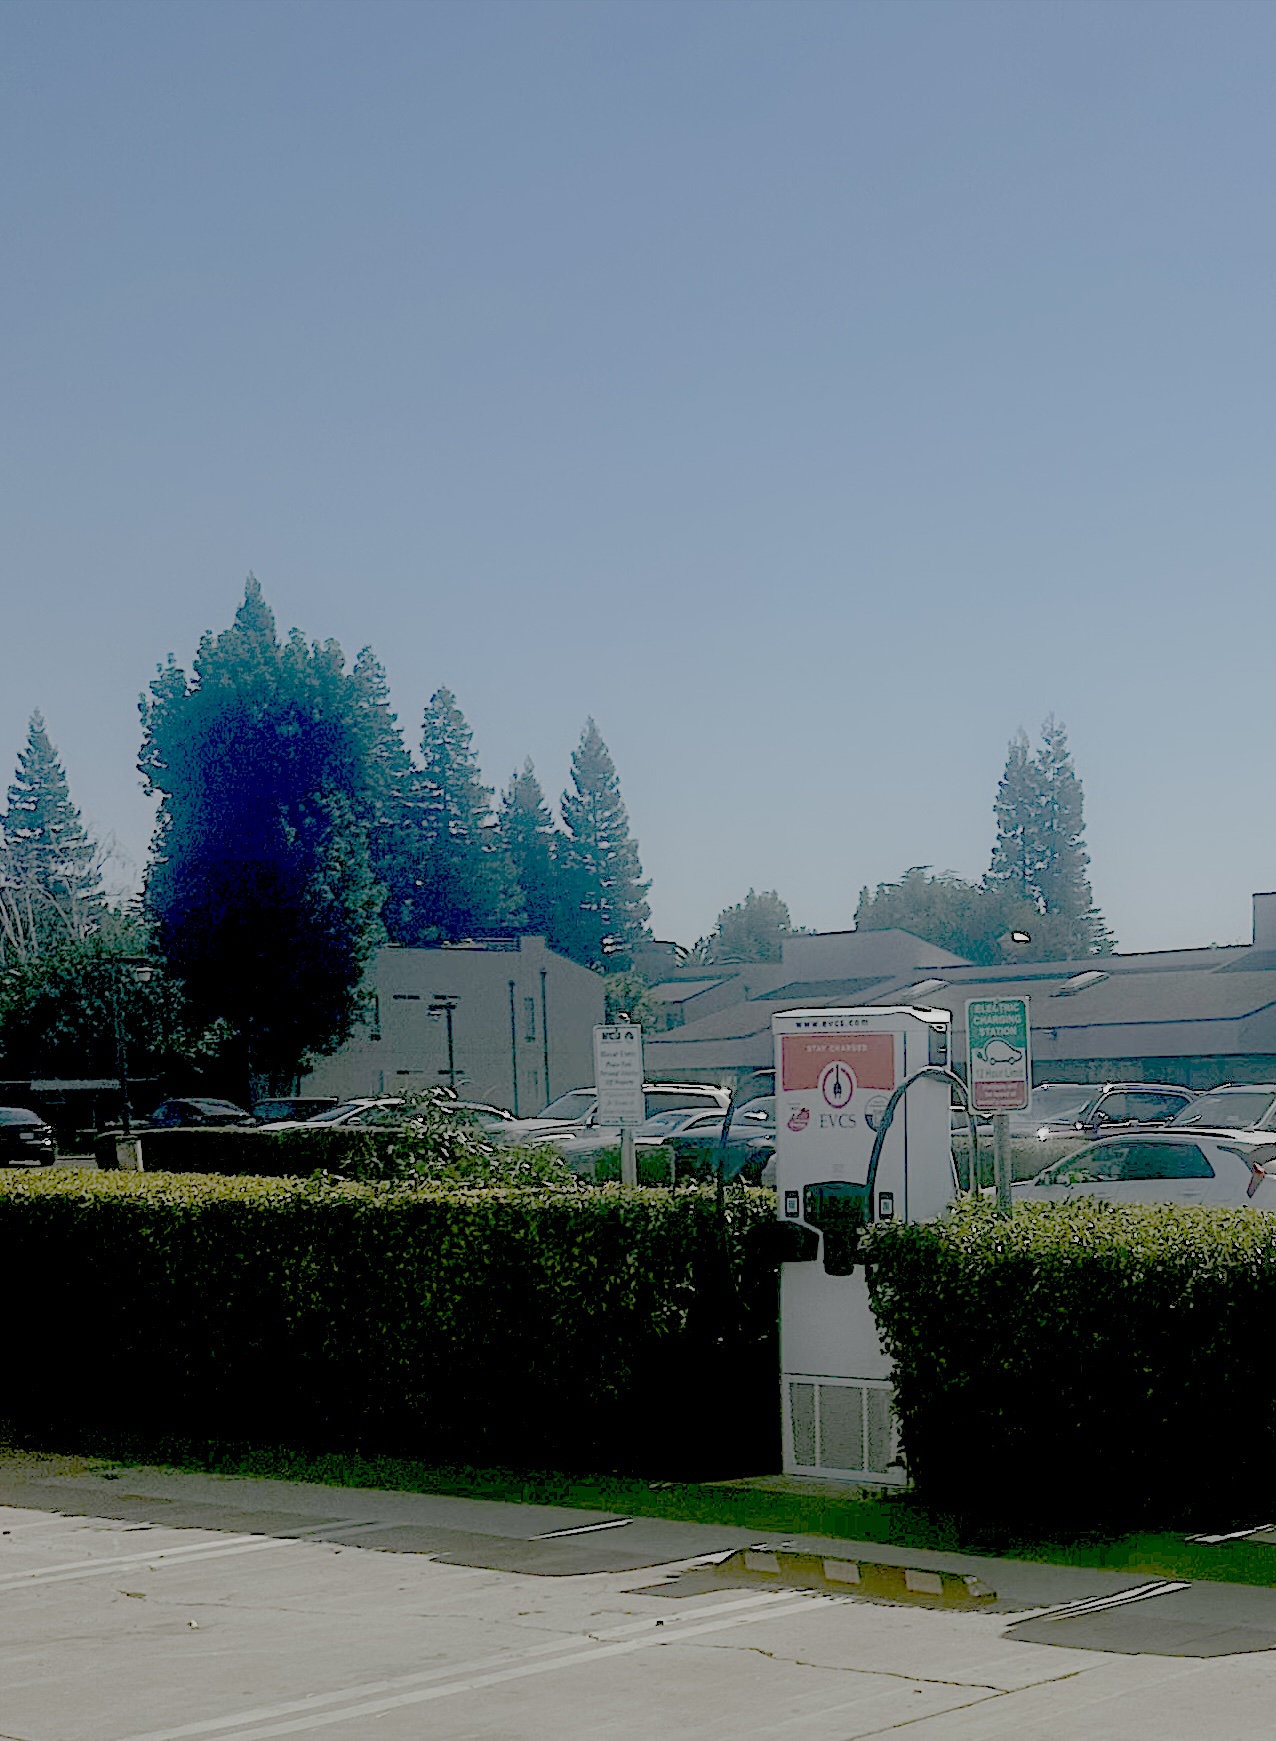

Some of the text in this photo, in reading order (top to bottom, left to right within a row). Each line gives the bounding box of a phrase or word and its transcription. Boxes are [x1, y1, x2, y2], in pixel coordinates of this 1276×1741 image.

[974, 1003, 1020, 1012] ELECTRIC
[973, 1015, 1022, 1025] CHARGING
[980, 1027, 1017, 1036] STATION
[820, 1113, 857, 1129] EVCS
